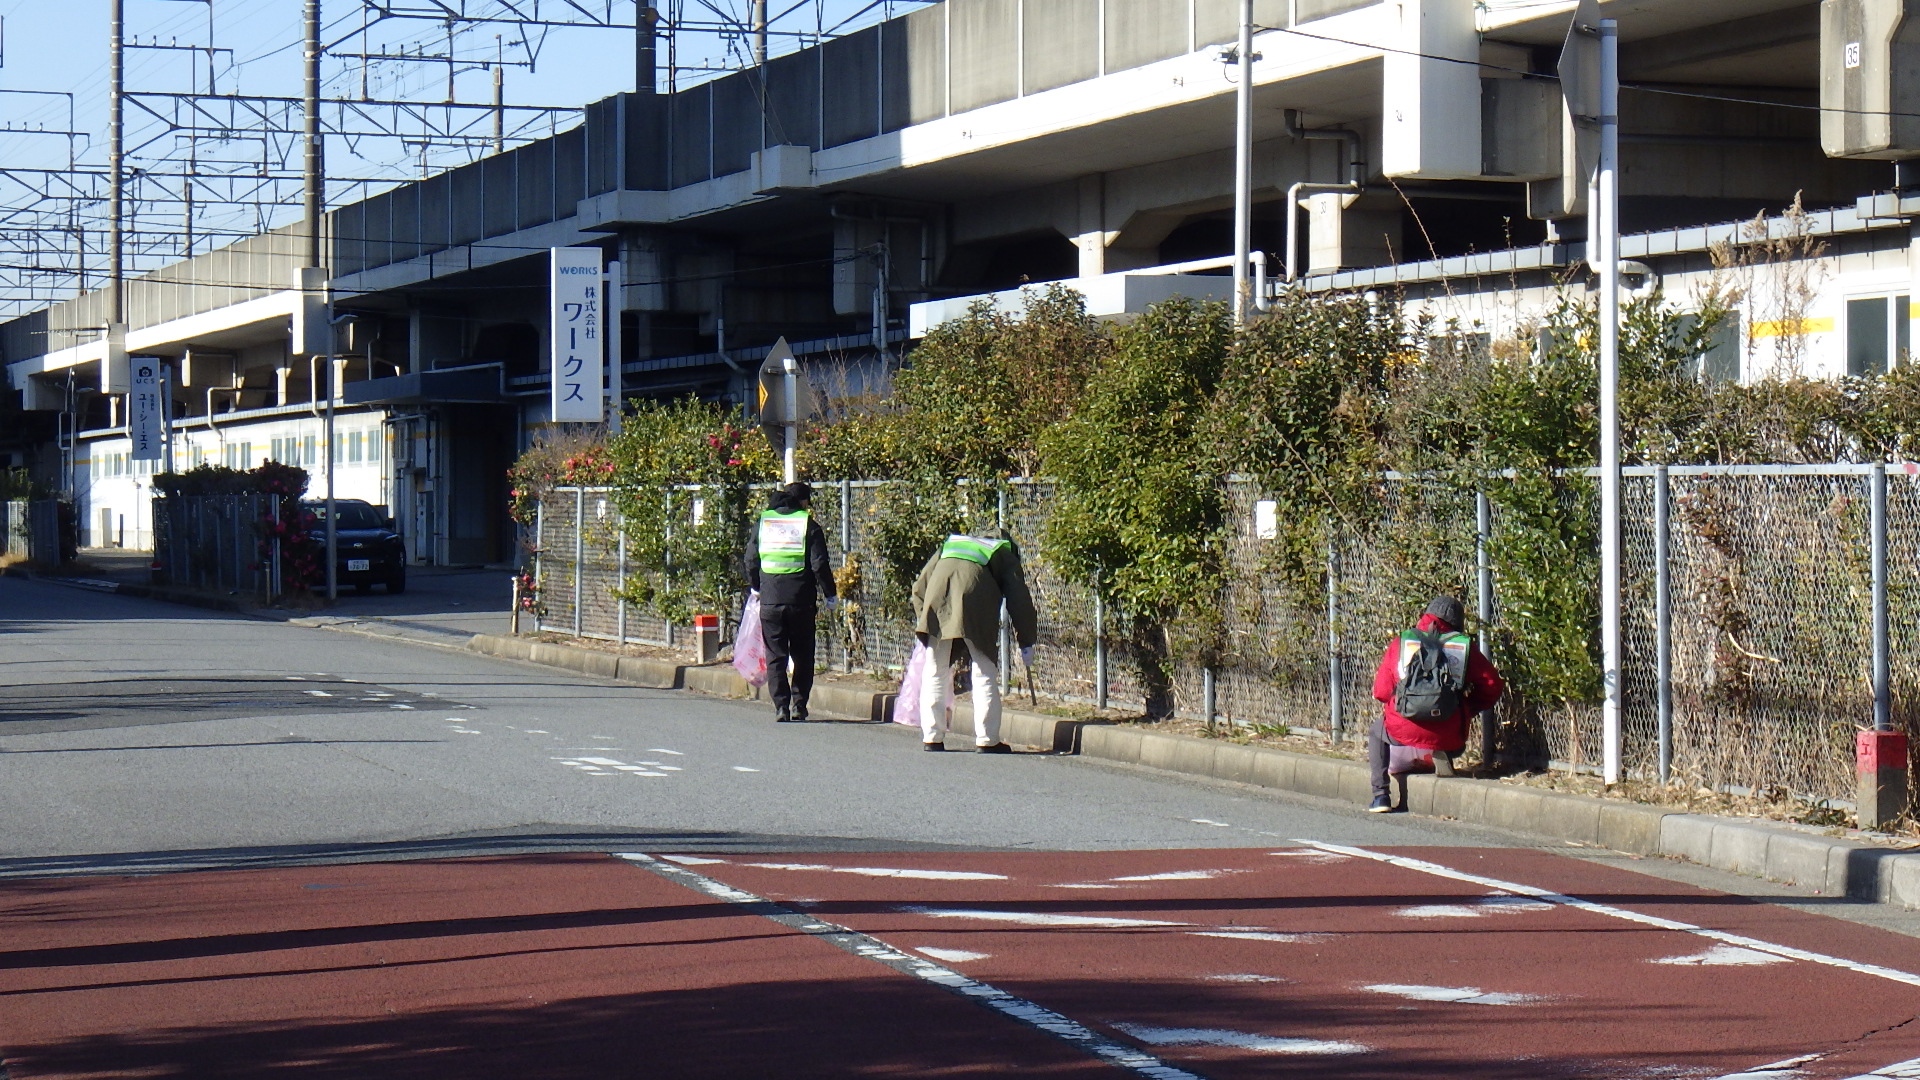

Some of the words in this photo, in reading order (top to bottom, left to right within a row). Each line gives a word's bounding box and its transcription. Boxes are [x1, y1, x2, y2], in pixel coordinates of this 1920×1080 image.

[1848, 46, 1857, 65] 35
[560, 267, 597, 275] WORKS
[585, 286, 596, 339] 株式会社
[563, 303, 584, 402] ワークス
[138, 394, 147, 450] ユー・シー・エス
